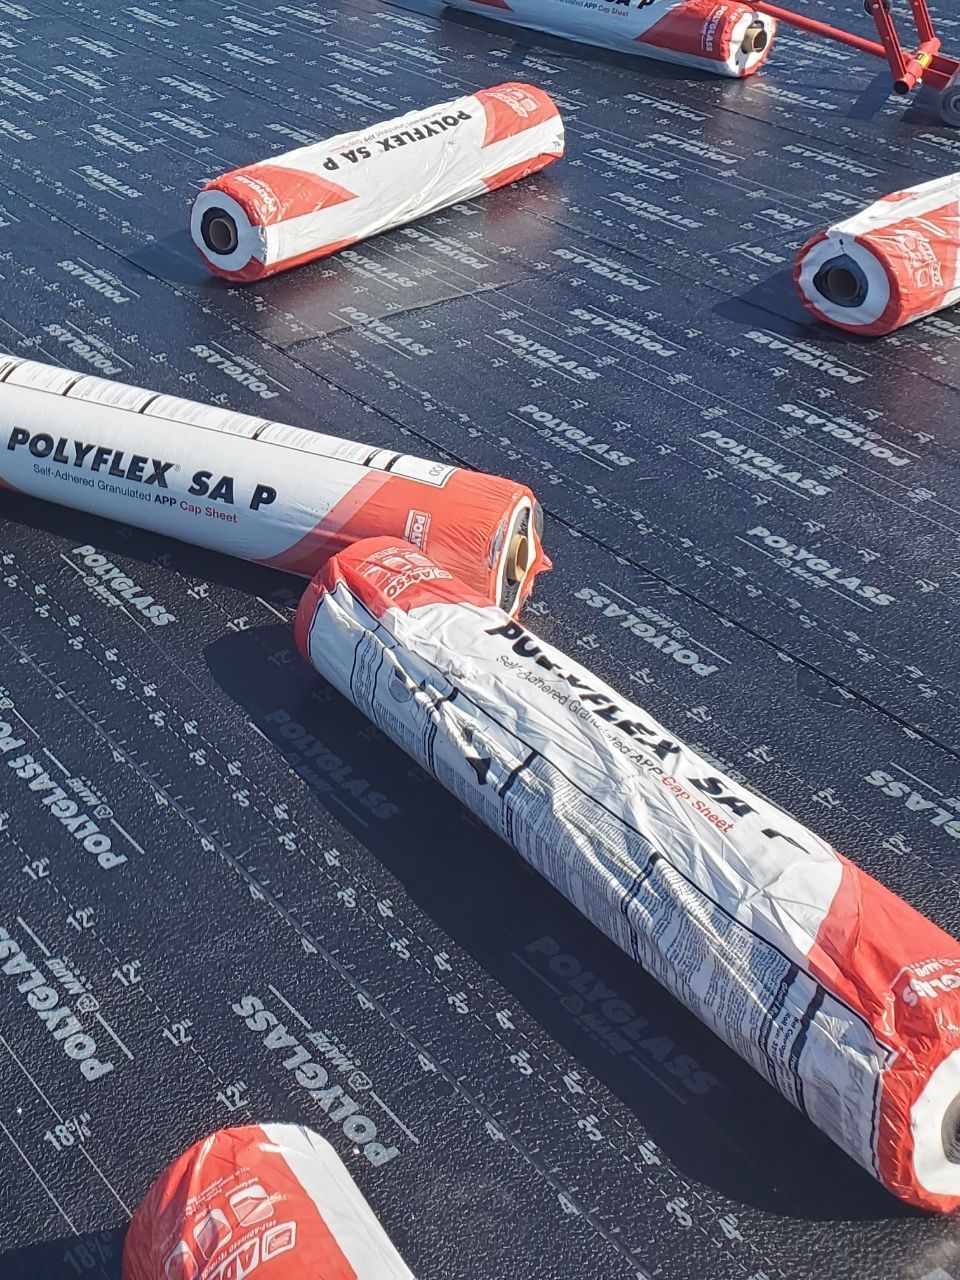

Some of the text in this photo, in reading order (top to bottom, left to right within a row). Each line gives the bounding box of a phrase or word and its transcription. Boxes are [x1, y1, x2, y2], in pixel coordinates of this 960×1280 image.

[583, 1, 598, 11] APP
[624, 93, 707, 121] POLYGLASS
[752, 82, 838, 110] POLYGLASS
[340, 146, 372, 165] SA
[377, 110, 472, 153] POLYFLEX
[648, 134, 739, 165] POLYGLASS
[322, 157, 342, 171] P
[590, 148, 680, 180] POLYGLASS
[782, 145, 878, 177] POLYGLASS
[340, 250, 418, 288] OLYGLASS
[399, 228, 488, 269] POLYGLASS
[551, 249, 651, 292] POLYGLASS
[58, 261, 131, 304] POLYGLASS
[43, 324, 122, 375] POLYGLASS
[339, 306, 435, 357] POLYGLASS
[494, 328, 602, 381] POLYGLASS
[569, 308, 677, 357] POLYGLASS
[190, 344, 280, 400] POLYGLASS
[744, 331, 864, 384] POLYGLASS
[517, 404, 636, 467] POLYGLASS
[778, 403, 911, 466] POLYGLASS
[699, 430, 834, 497] POLYGLASS
[33, 463, 238, 524] Self-Adhered Granulated APP Cap Sheet
[187, 470, 235, 505] SA
[249, 483, 278, 511] P
[72, 545, 178, 627] POLYGLASS
[747, 527, 896, 607] POLYGLASS
[574, 587, 720, 677] POLYGLASS
[264, 710, 401, 818] POLYGLASS
[8, 753, 128, 871] POLYGLASS
[630, 753, 665, 776] APP
[661, 773, 691, 800] Cap
[691, 799, 737, 834] Sheet
[525, 937, 724, 1095] POLYGLASS
[232, 995, 400, 1168] POLYGLASS
